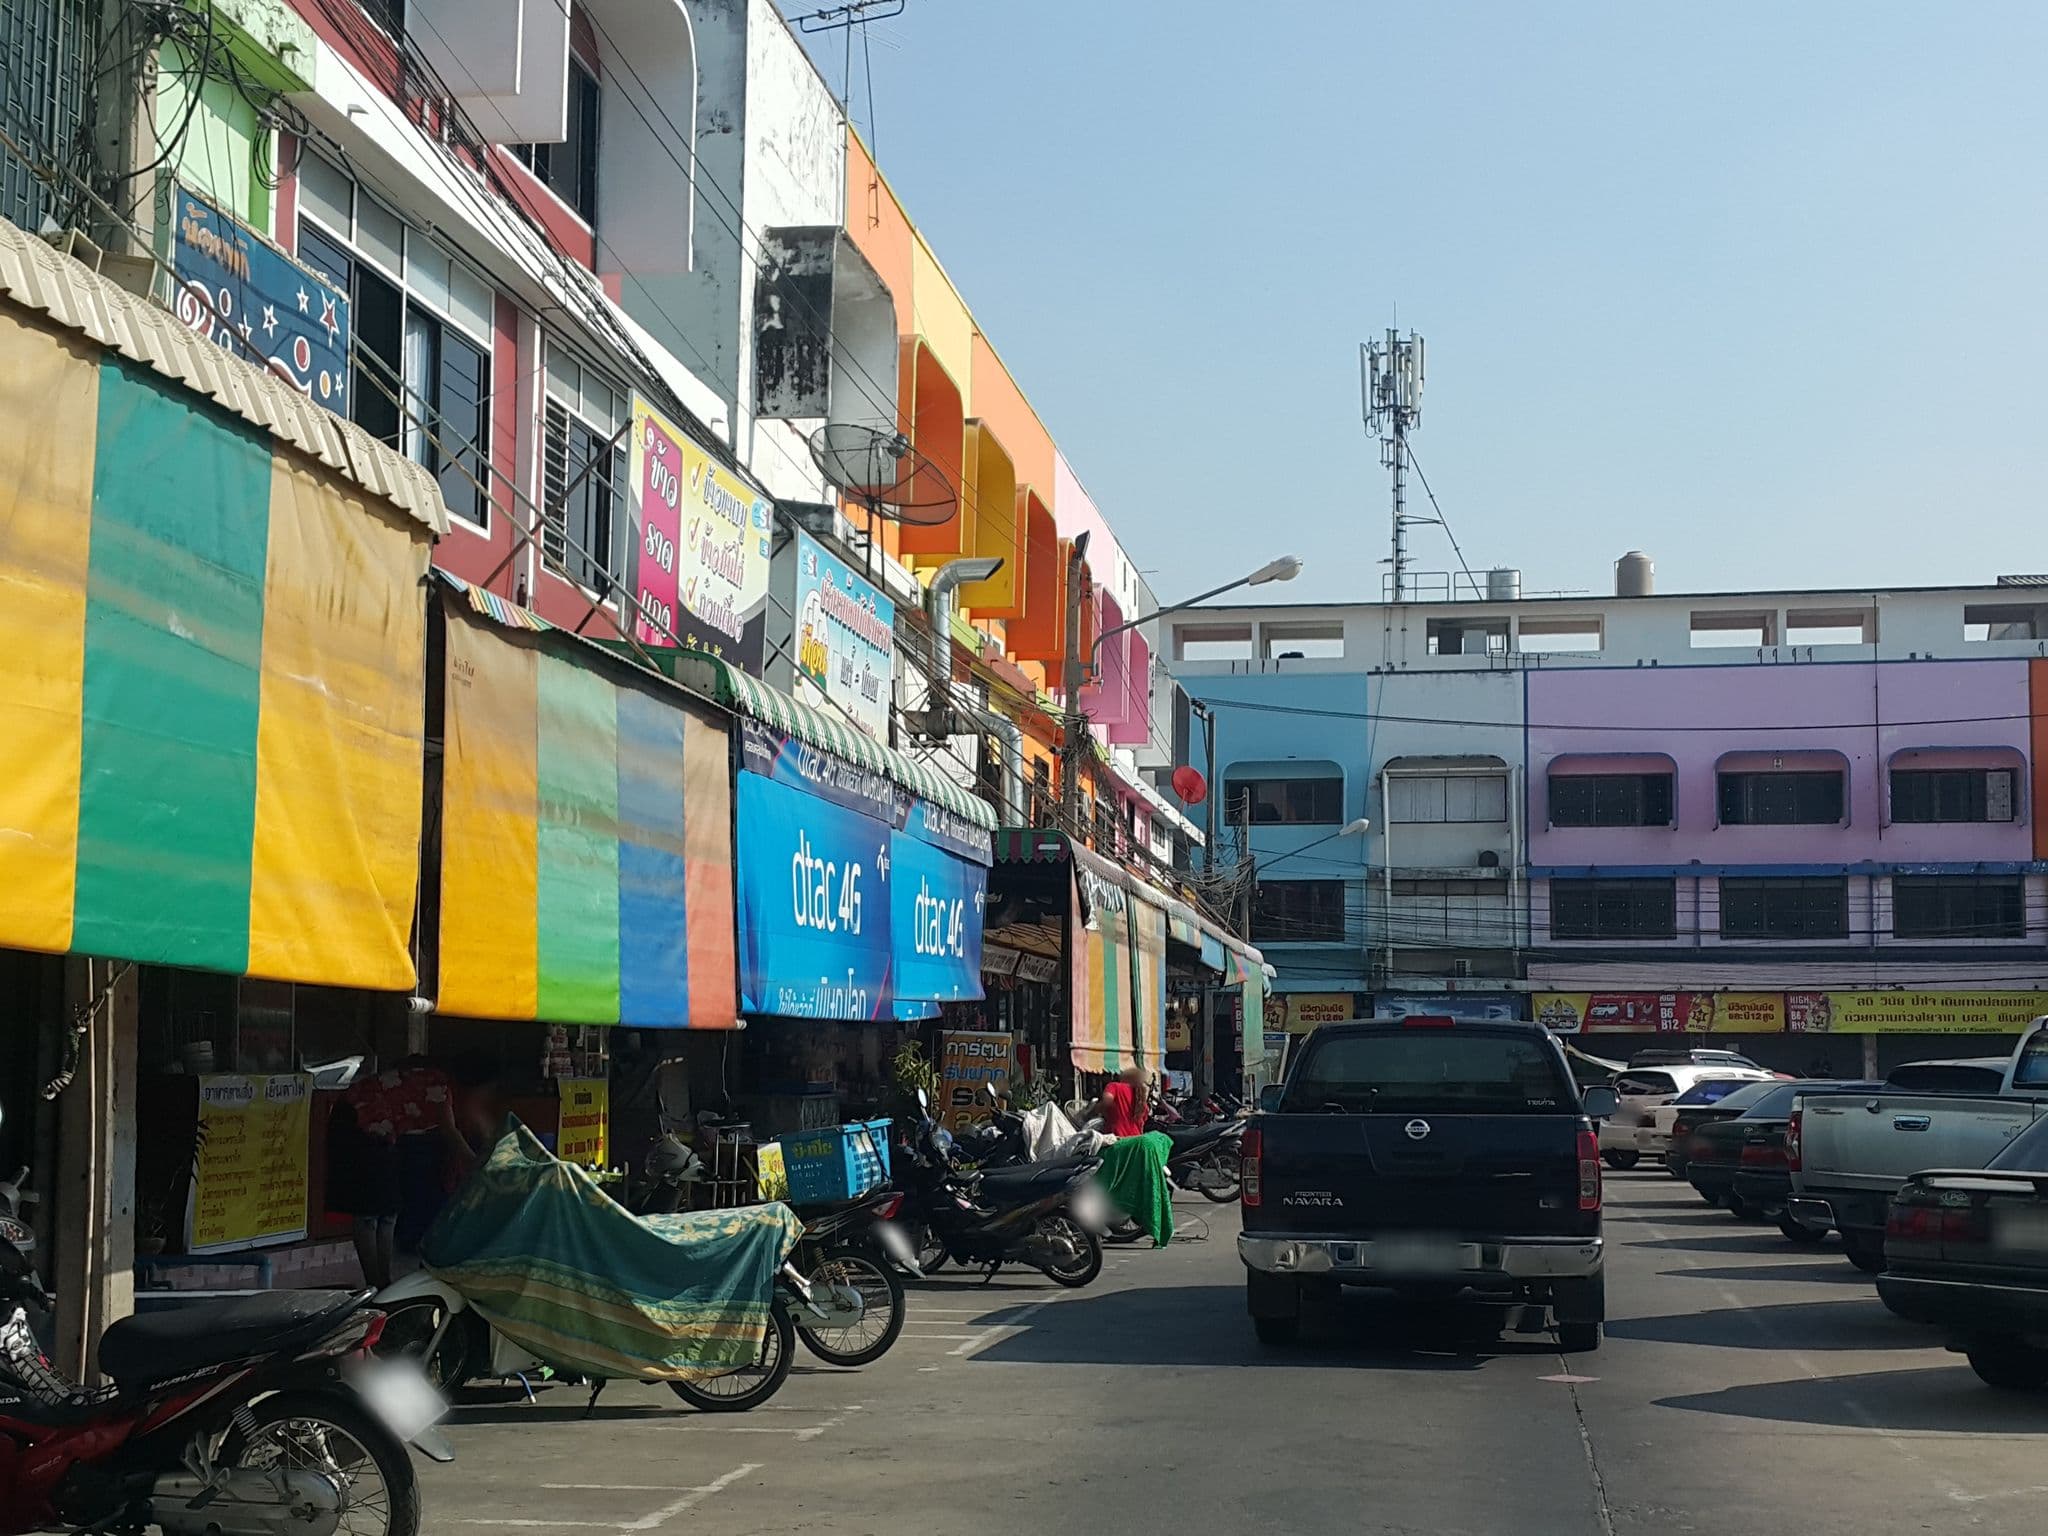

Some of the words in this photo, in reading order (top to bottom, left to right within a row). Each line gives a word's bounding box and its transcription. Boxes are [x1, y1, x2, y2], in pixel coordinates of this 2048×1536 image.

[651, 438, 678, 510] ข้าว
[646, 522, 674, 574] ราด
[792, 829, 837, 933] dtac
[838, 861, 861, 936] 4G
[915, 874, 945, 957] dtac
[947, 898, 963, 958] 4G
[1660, 1008, 1673, 1019] B6
[1661, 1019, 1679, 1031] B12
[946, 1038, 1008, 1062] การ์ตูน
[944, 1062, 1006, 1081] รับฝาก
[1282, 1197, 1344, 1207] NAVARA
